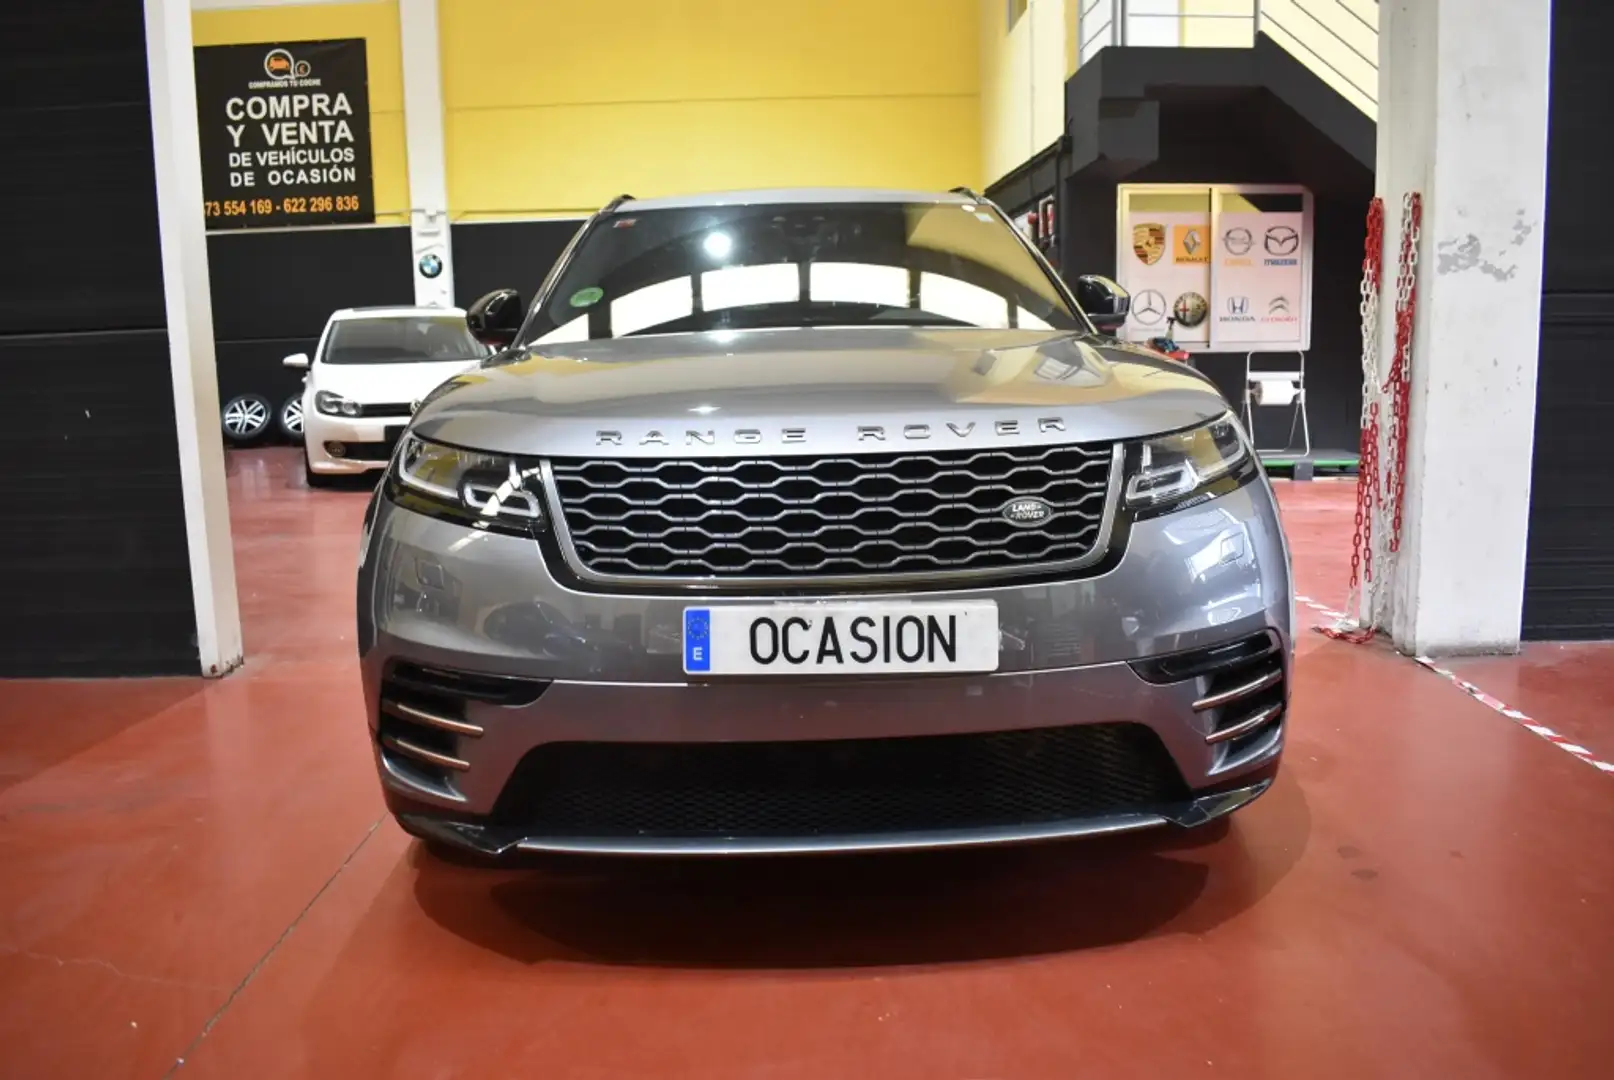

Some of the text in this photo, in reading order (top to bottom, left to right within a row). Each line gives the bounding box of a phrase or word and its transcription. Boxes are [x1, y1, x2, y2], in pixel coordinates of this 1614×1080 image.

[226, 92, 353, 121] COMPRA
[226, 120, 355, 148] Y VENTA
[228, 147, 355, 168] DE VEHÍCULOS
[229, 164, 356, 187] DE OCASIÓN
[204, 201, 221, 217] 73
[223, 200, 246, 216] 554
[250, 199, 273, 215] 169
[283, 197, 307, 213] 622
[309, 196, 333, 212] 296
[335, 195, 360, 211] 836
[595, 416, 1067, 446] RANGE ROVER
[749, 614, 957, 665] OCASION
[692, 647, 704, 661] E
